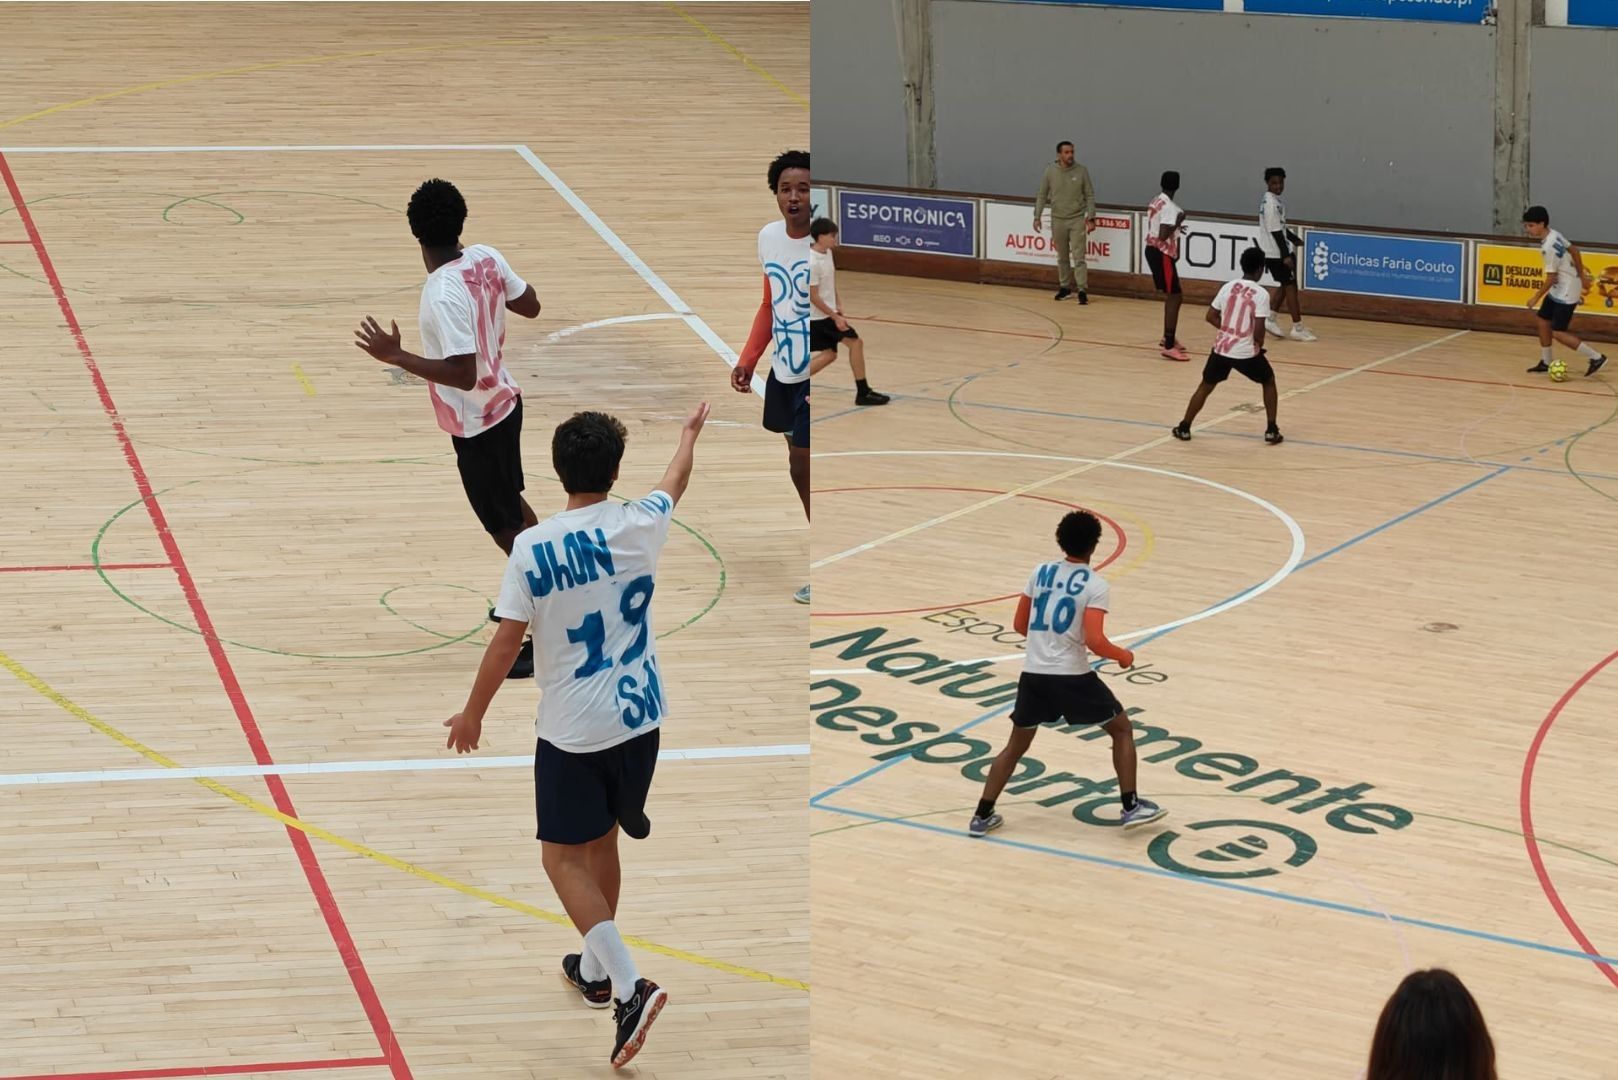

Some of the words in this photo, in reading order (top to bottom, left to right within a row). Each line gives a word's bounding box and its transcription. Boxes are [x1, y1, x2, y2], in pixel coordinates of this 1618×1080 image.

[1006, 234, 1046, 250] AUTO
[1330, 252, 1379, 267] Clínicas
[1382, 256, 1412, 271] Faria
[1415, 259, 1455, 274] Couto
[566, 574, 655, 679] 19
[1030, 590, 1076, 634] 10
